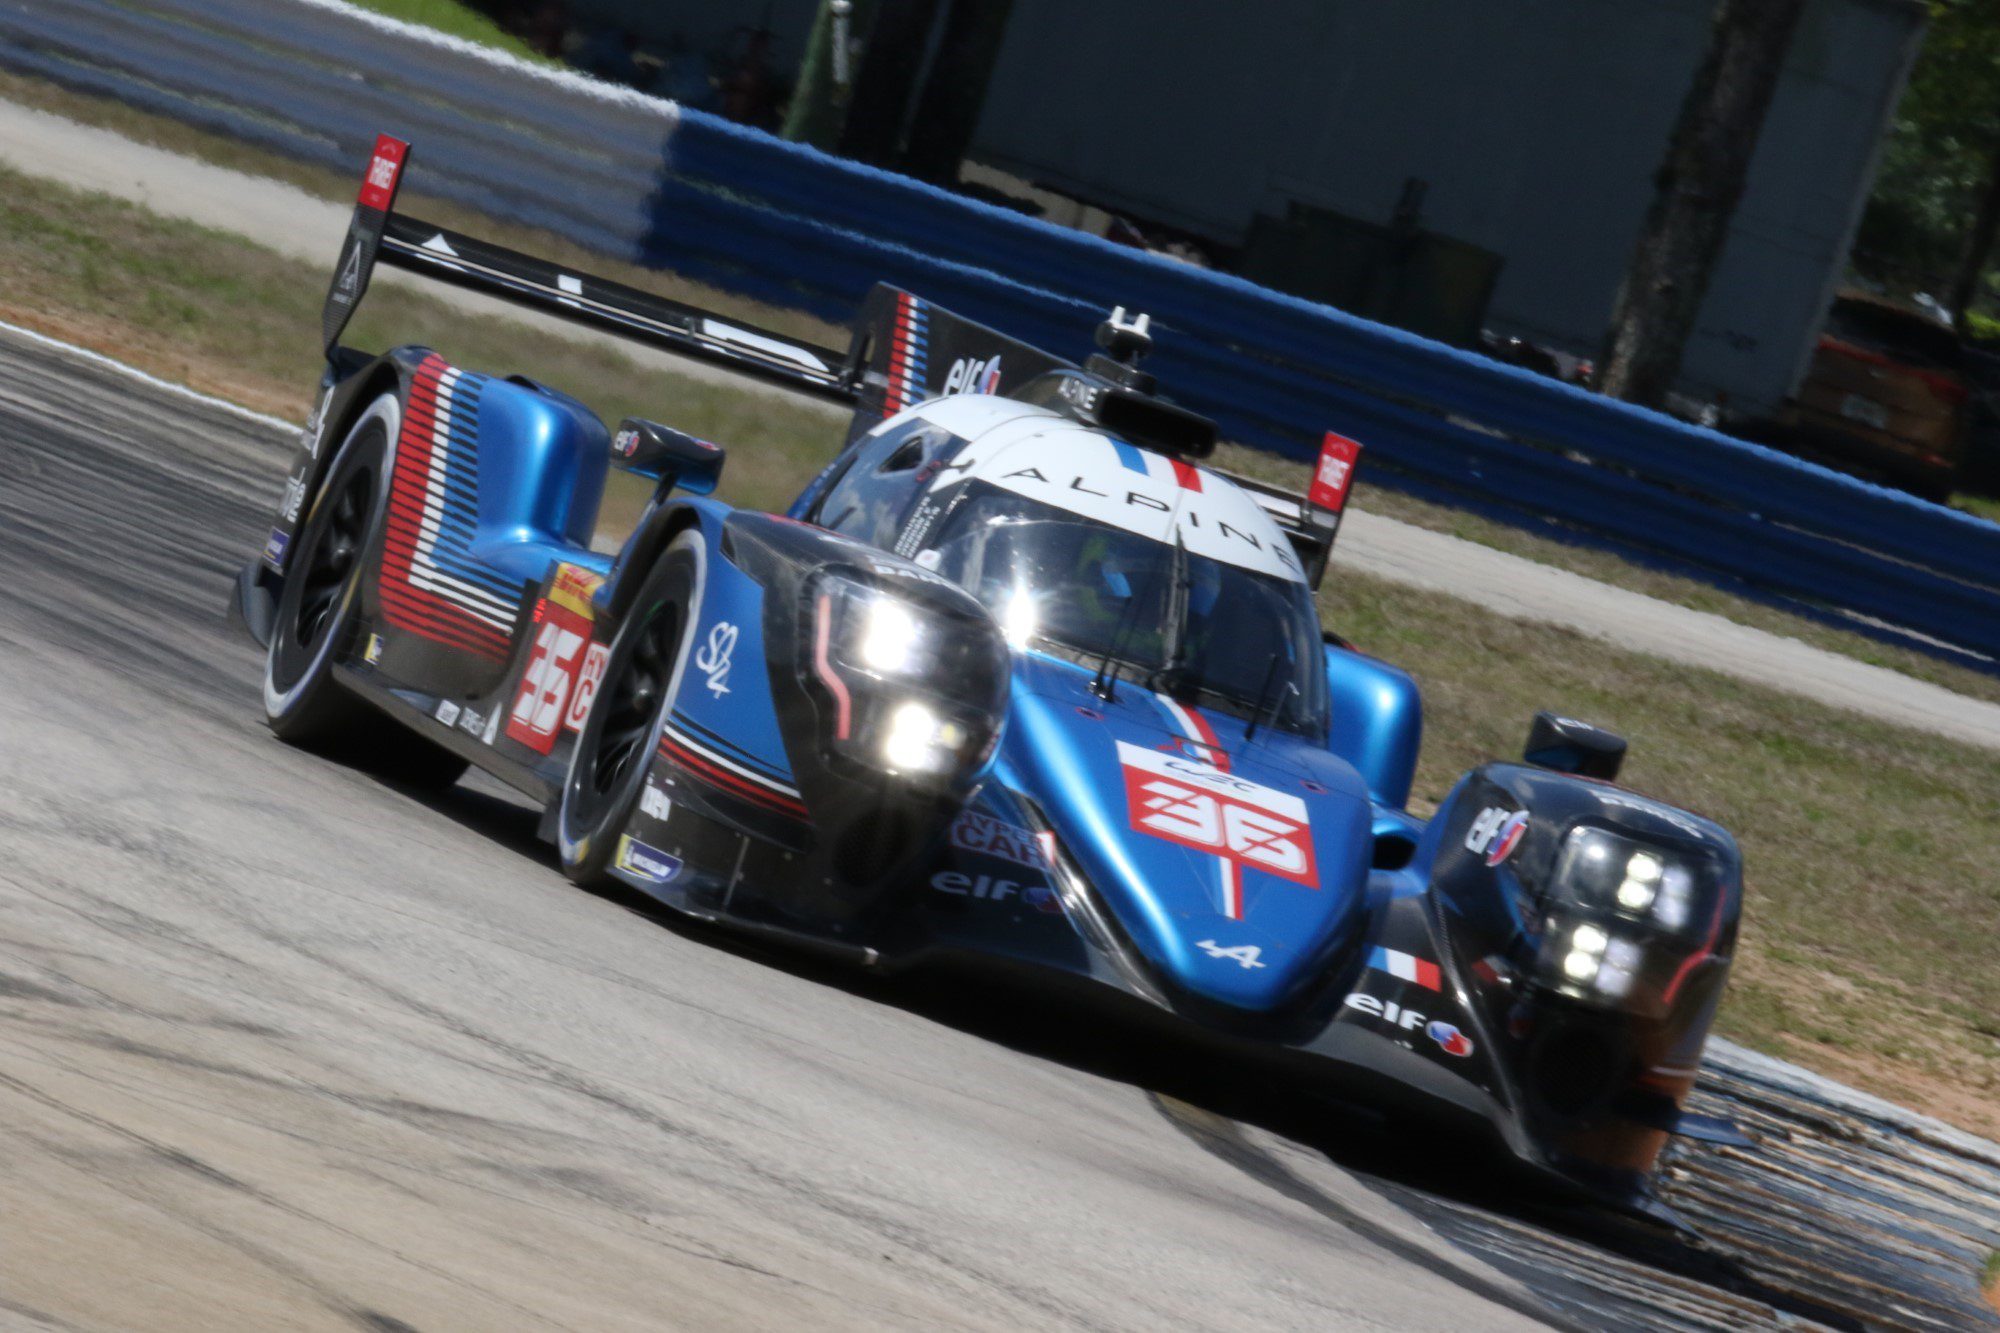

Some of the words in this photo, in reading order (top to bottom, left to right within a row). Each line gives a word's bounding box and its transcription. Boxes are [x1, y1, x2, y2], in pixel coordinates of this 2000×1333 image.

[1001, 467, 1302, 575] ALPINE
[1163, 761, 1257, 792] WEC
[1139, 780, 1308, 875] 36
[930, 870, 1020, 901] elf
[1344, 992, 1427, 1030] elf
